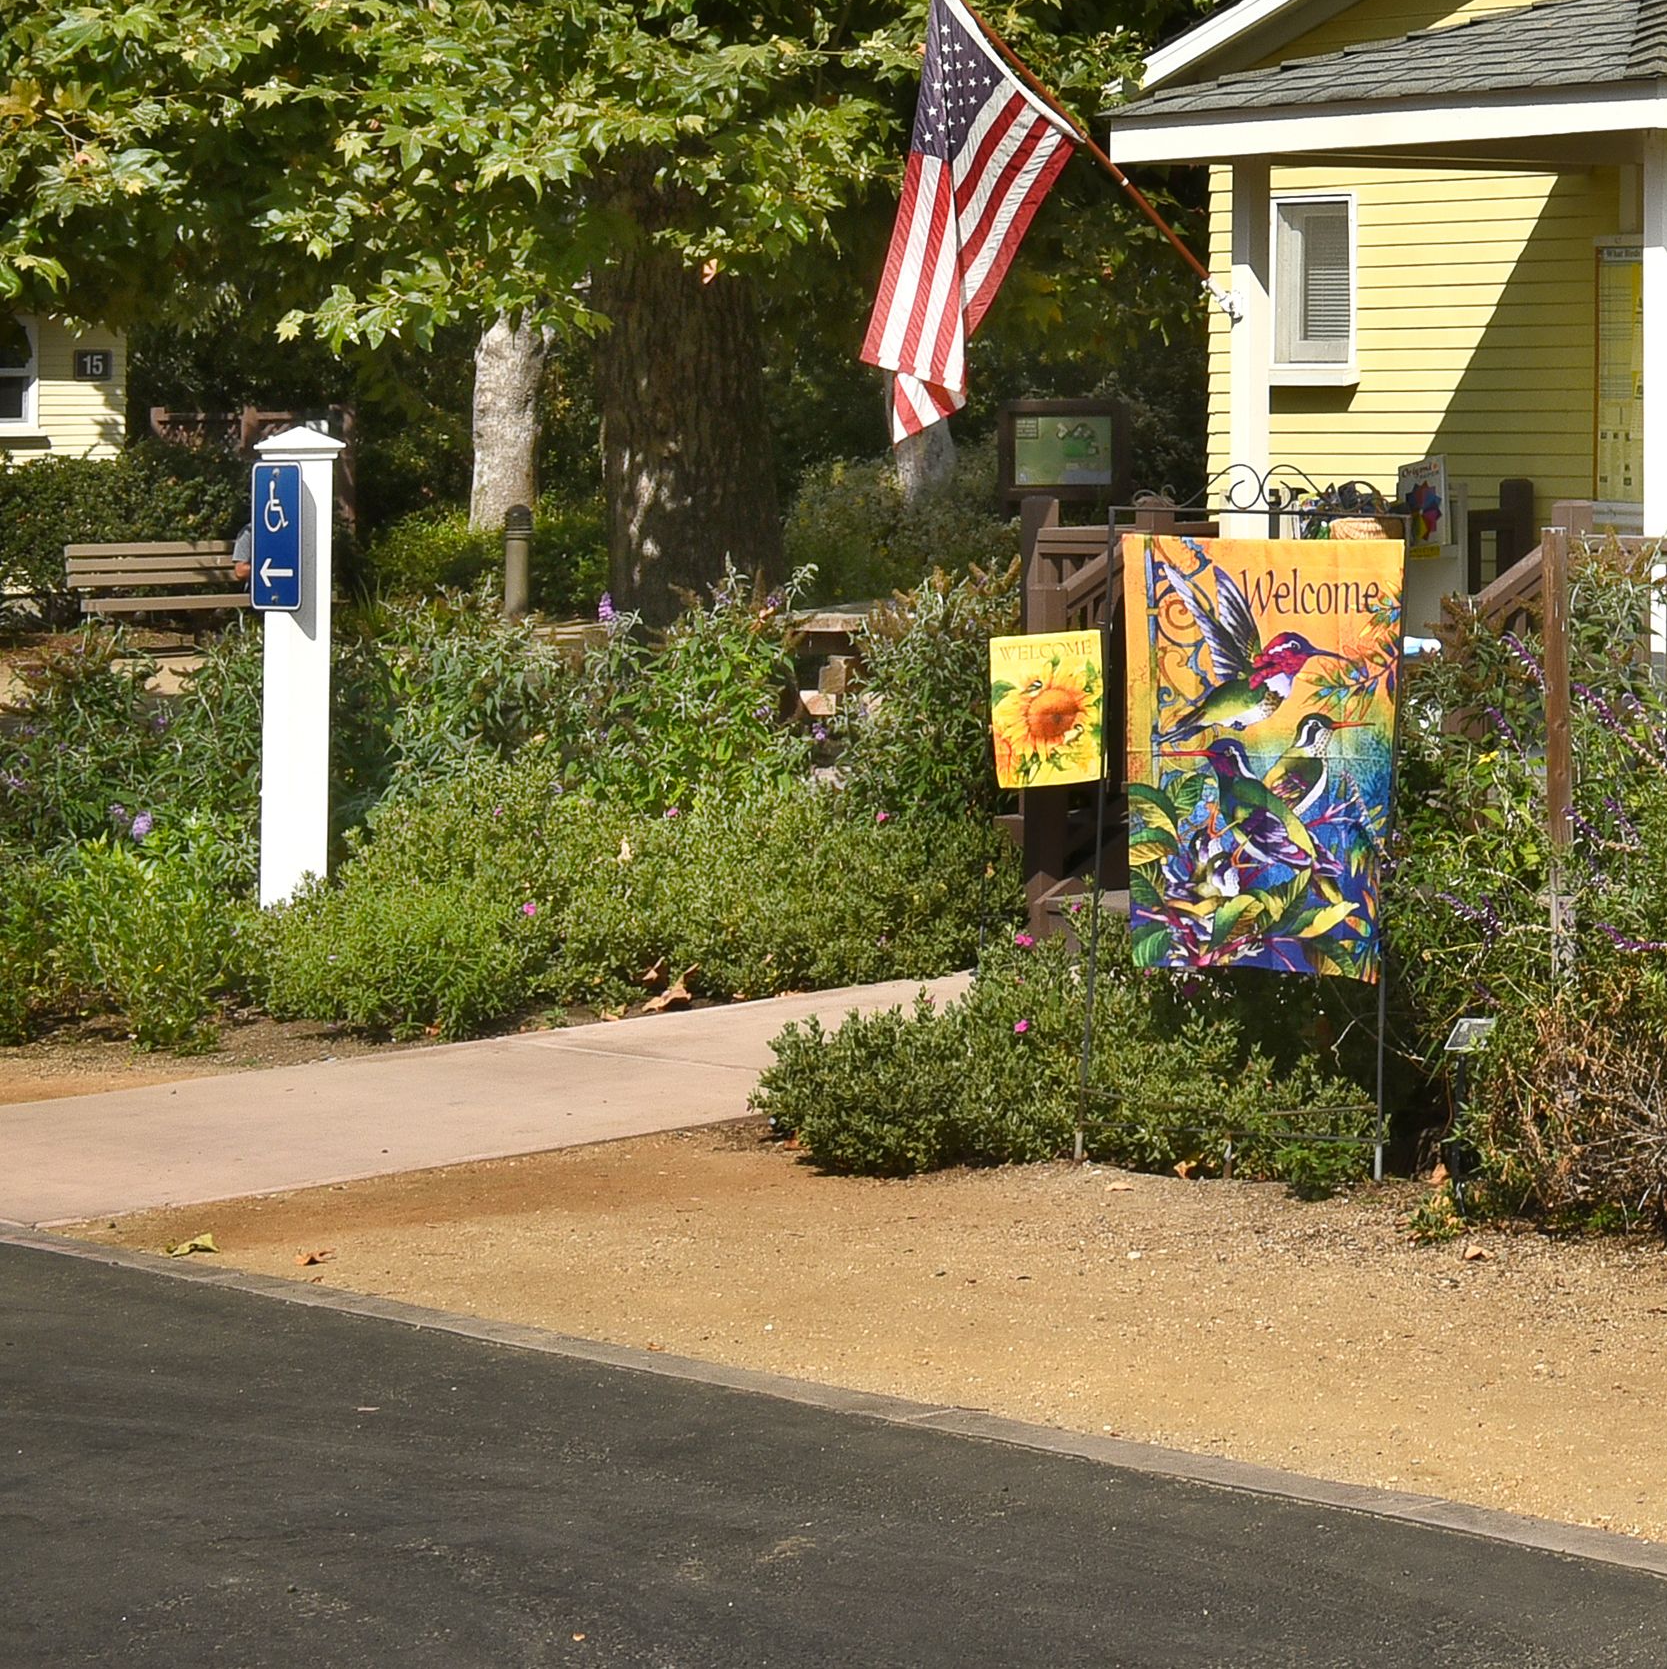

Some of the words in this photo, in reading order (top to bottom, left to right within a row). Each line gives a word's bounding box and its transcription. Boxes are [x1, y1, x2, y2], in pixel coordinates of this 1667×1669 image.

[83, 354, 103, 375] 15
[1239, 567, 1379, 617] Welcome
[999, 639, 1092, 661] WELCOME
